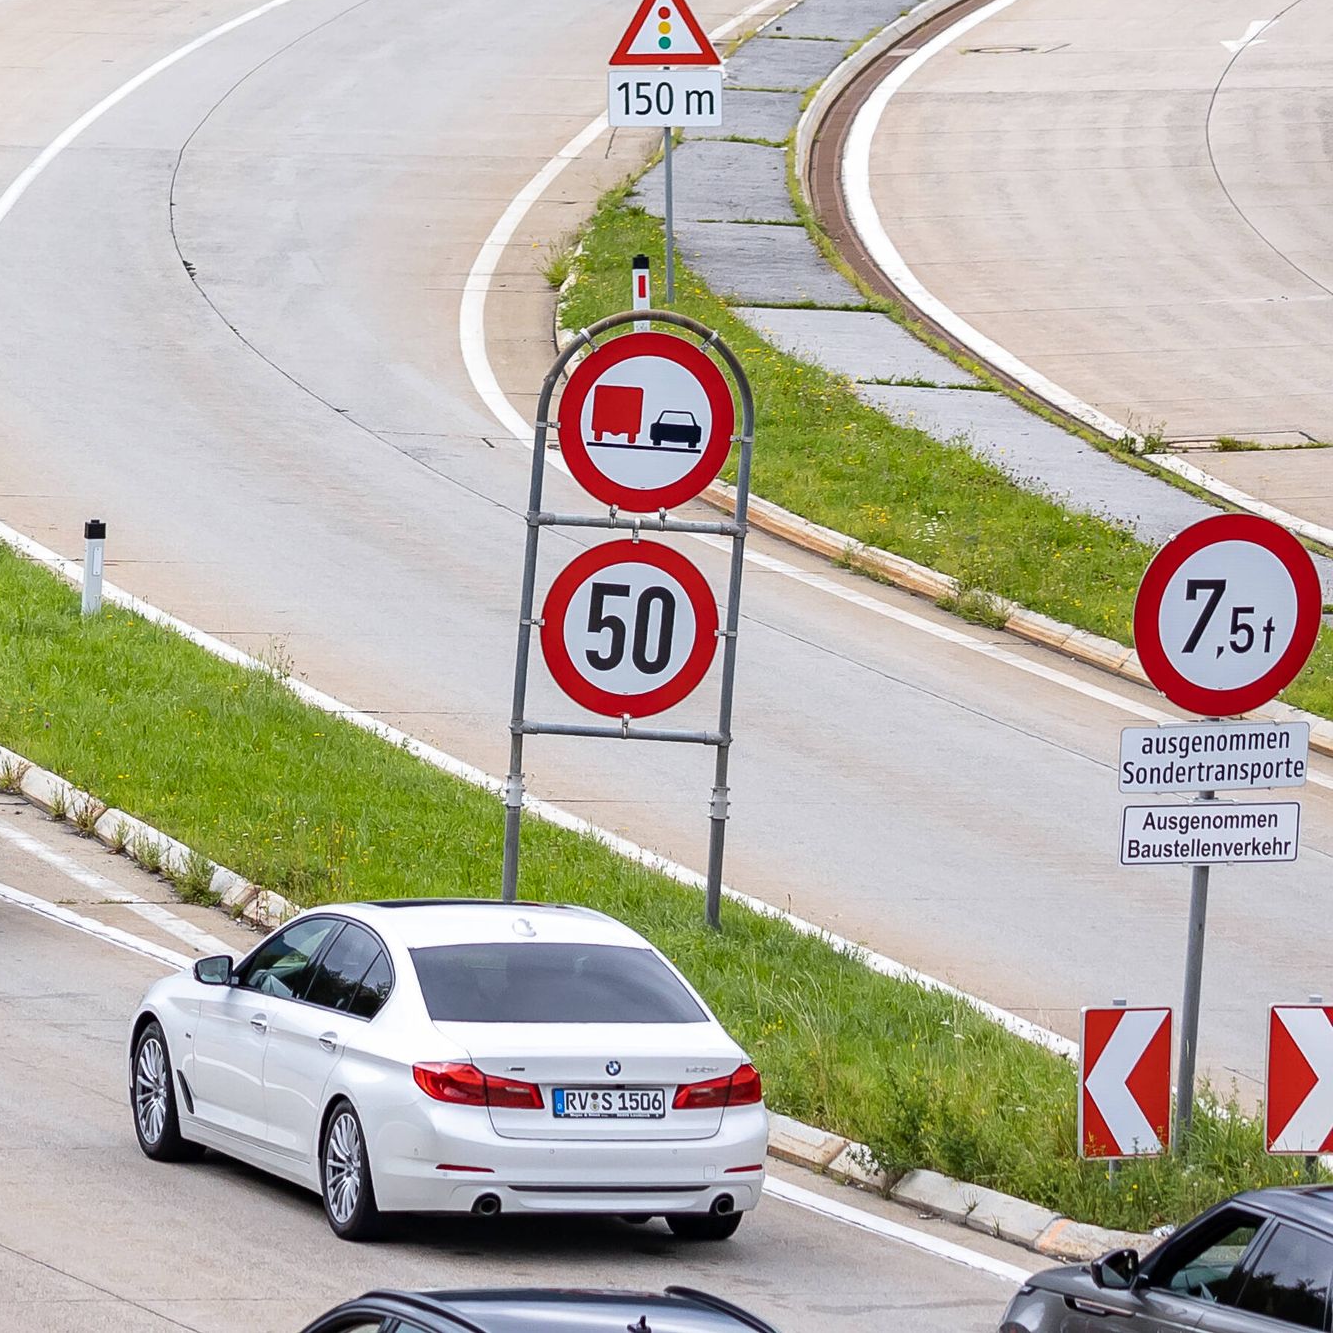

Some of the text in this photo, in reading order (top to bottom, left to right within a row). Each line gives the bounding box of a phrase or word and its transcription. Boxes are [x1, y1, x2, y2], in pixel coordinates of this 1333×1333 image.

[616, 81, 715, 116] 150 m
[585, 581, 676, 675] 50
[1141, 730, 1291, 759] ausgenommen
[1122, 757, 1304, 785] Sondertransporte
[1142, 811, 1279, 835] Ausgenommen
[1127, 837, 1292, 859] Baustellenverkehr
[565, 1092, 589, 1111] RV
[601, 1092, 613, 1111] S
[618, 1092, 663, 1111] 1506
